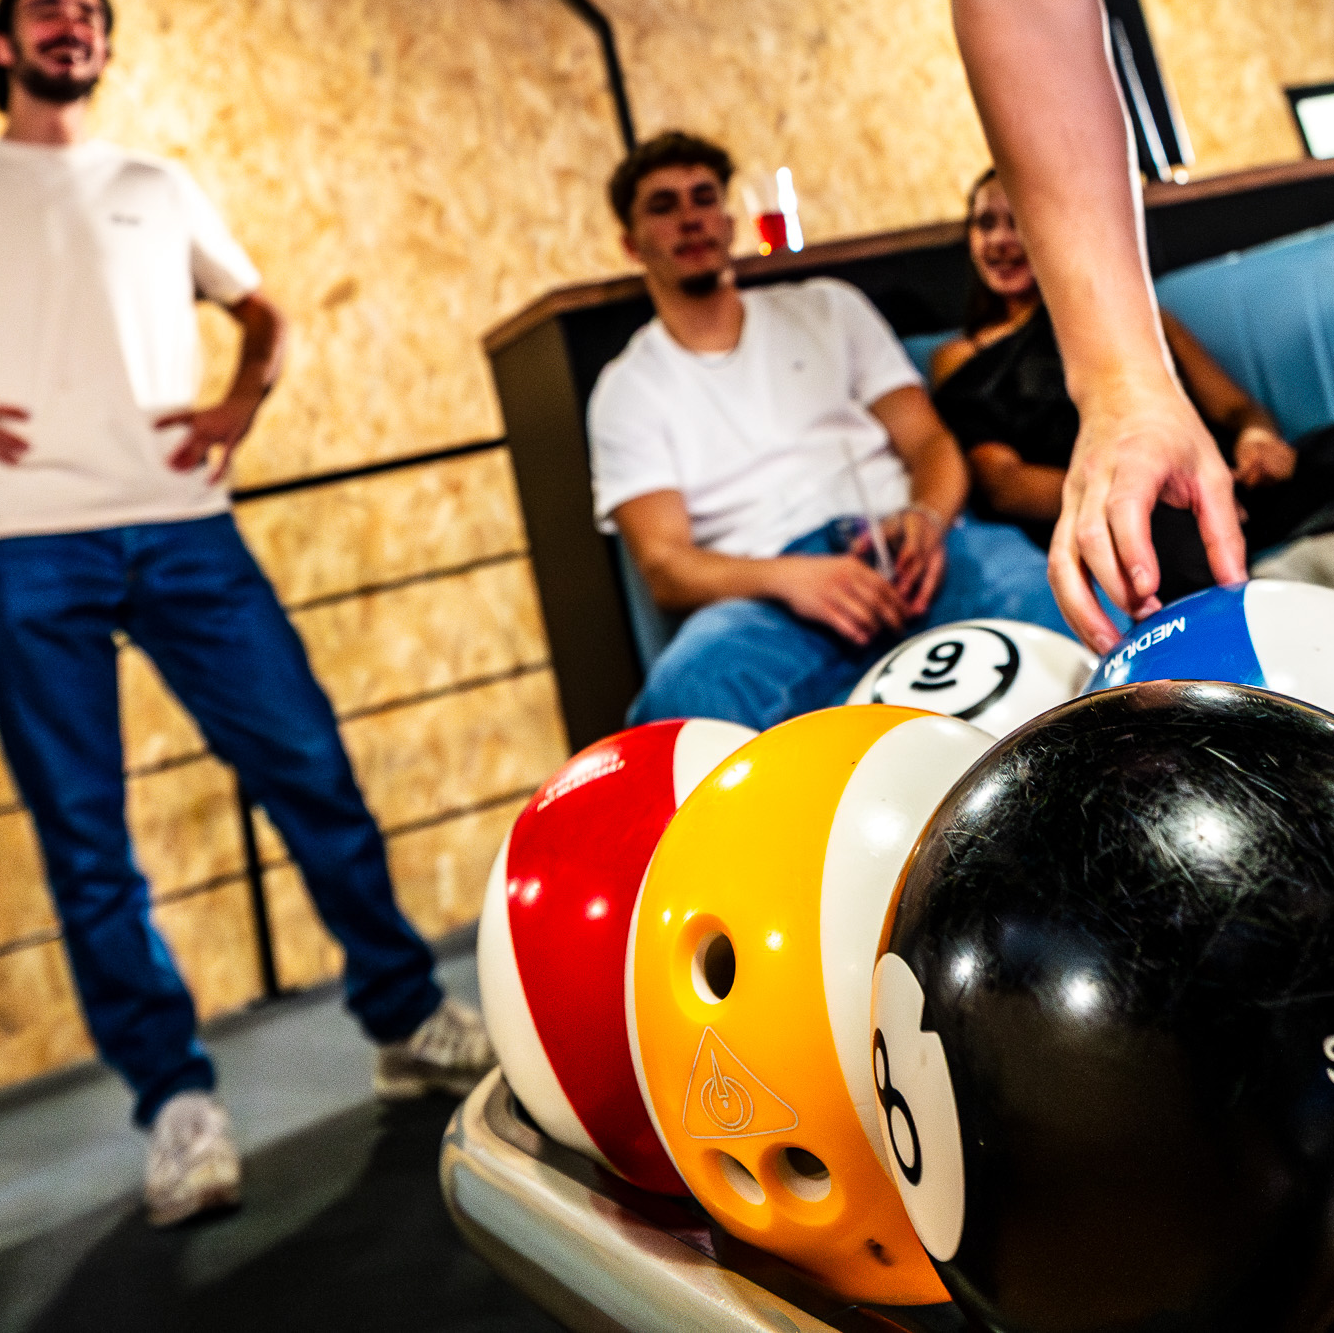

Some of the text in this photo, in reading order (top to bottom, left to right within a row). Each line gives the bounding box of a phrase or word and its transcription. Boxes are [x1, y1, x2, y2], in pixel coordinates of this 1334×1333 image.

[921, 641, 964, 678] 9
[1104, 617, 1185, 679] MEDIUM
[873, 1027, 922, 1187] 8
